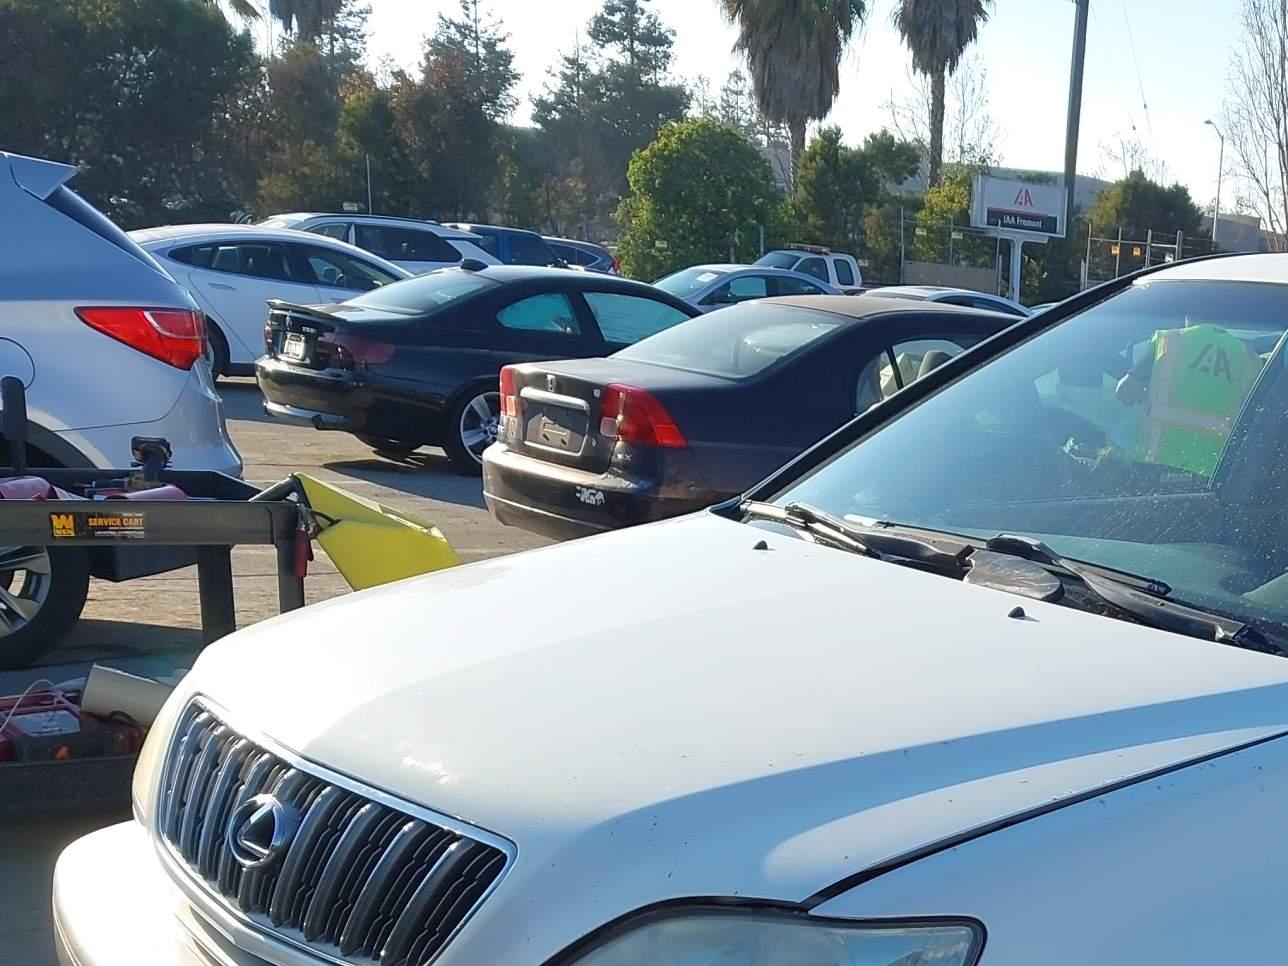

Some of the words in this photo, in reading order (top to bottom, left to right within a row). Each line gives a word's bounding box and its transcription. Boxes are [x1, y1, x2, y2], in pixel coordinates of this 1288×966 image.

[1003, 215, 1015, 225] IAA
[1016, 217, 1042, 229] Fremont
[88, 517, 121, 527] SERVICE
[122, 517, 144, 526] CART
